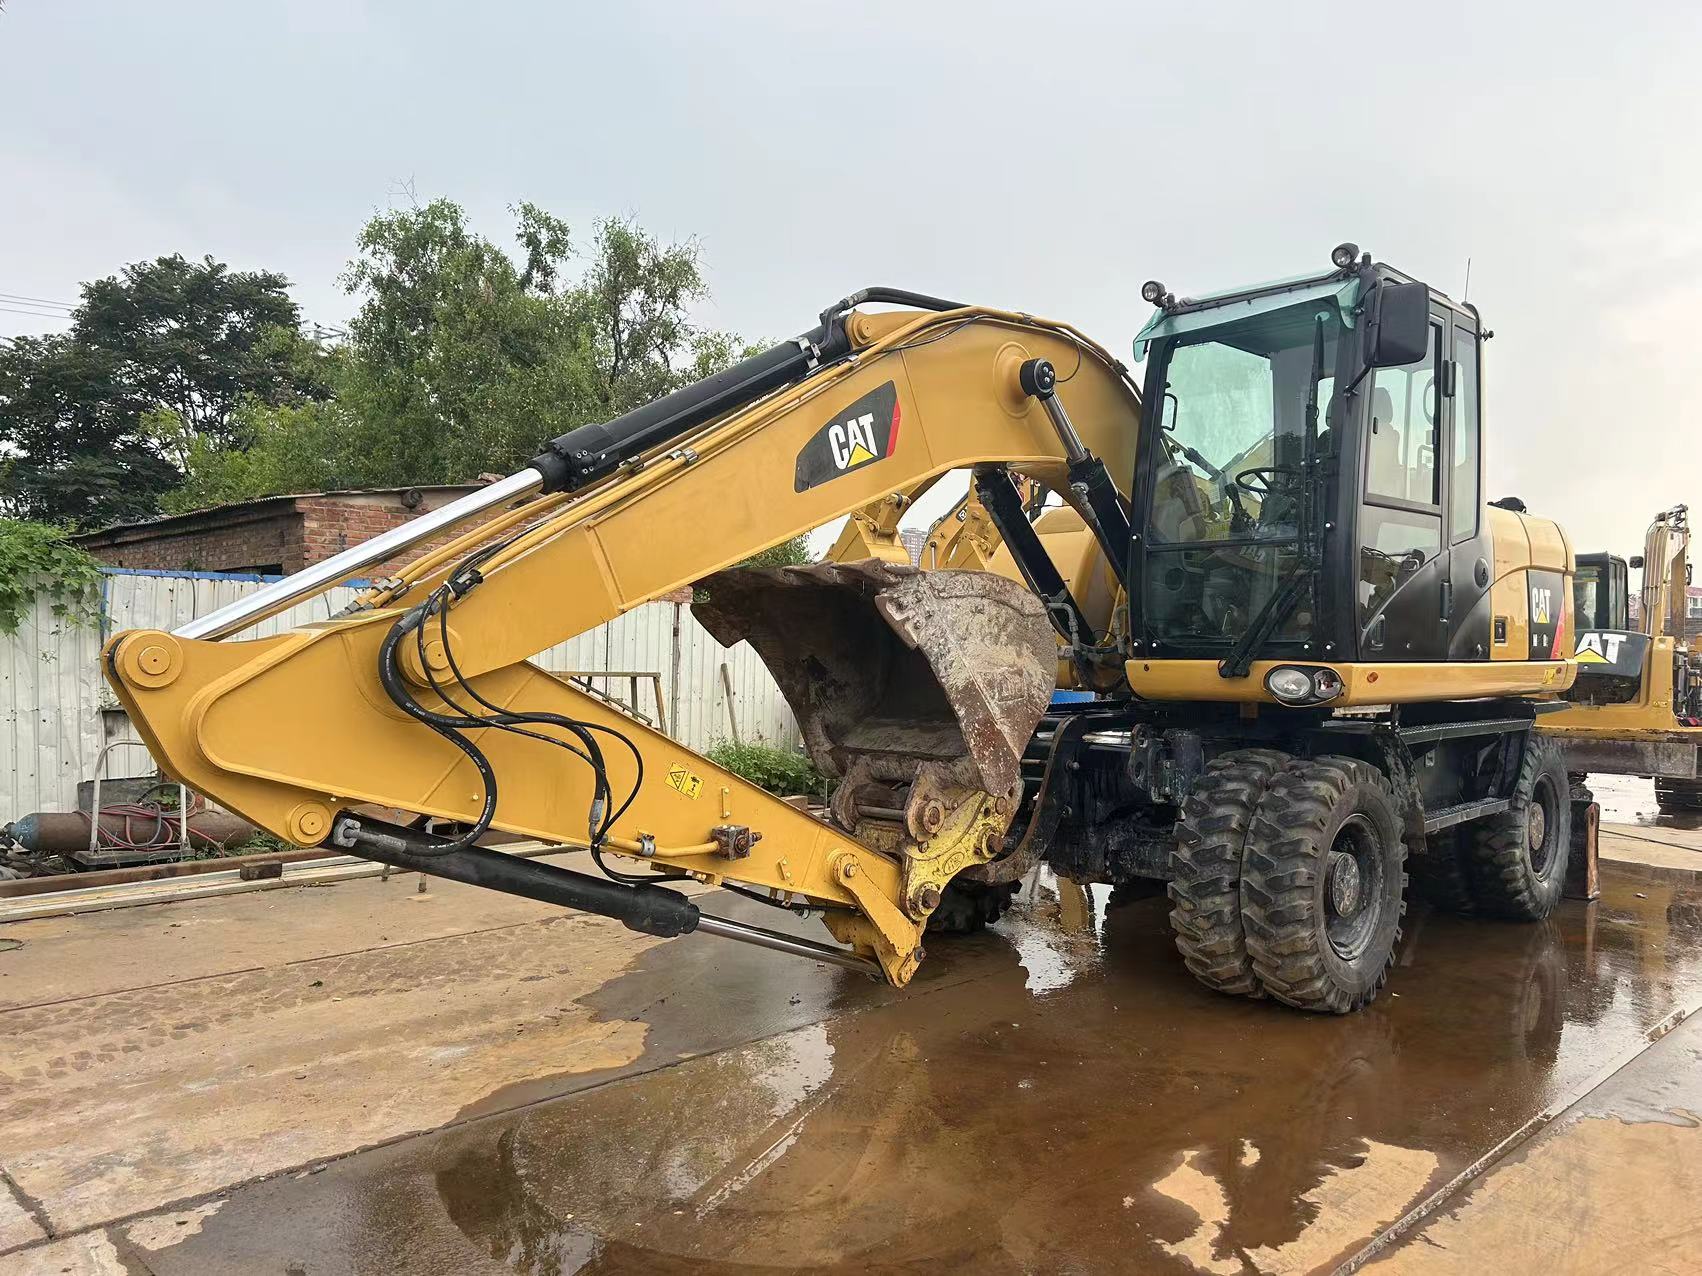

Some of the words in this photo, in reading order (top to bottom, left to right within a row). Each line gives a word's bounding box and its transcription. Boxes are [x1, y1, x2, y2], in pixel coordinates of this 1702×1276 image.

[828, 412, 878, 470] CAT
[1532, 587, 1551, 624] CAT
[1574, 632, 1627, 664] AT
